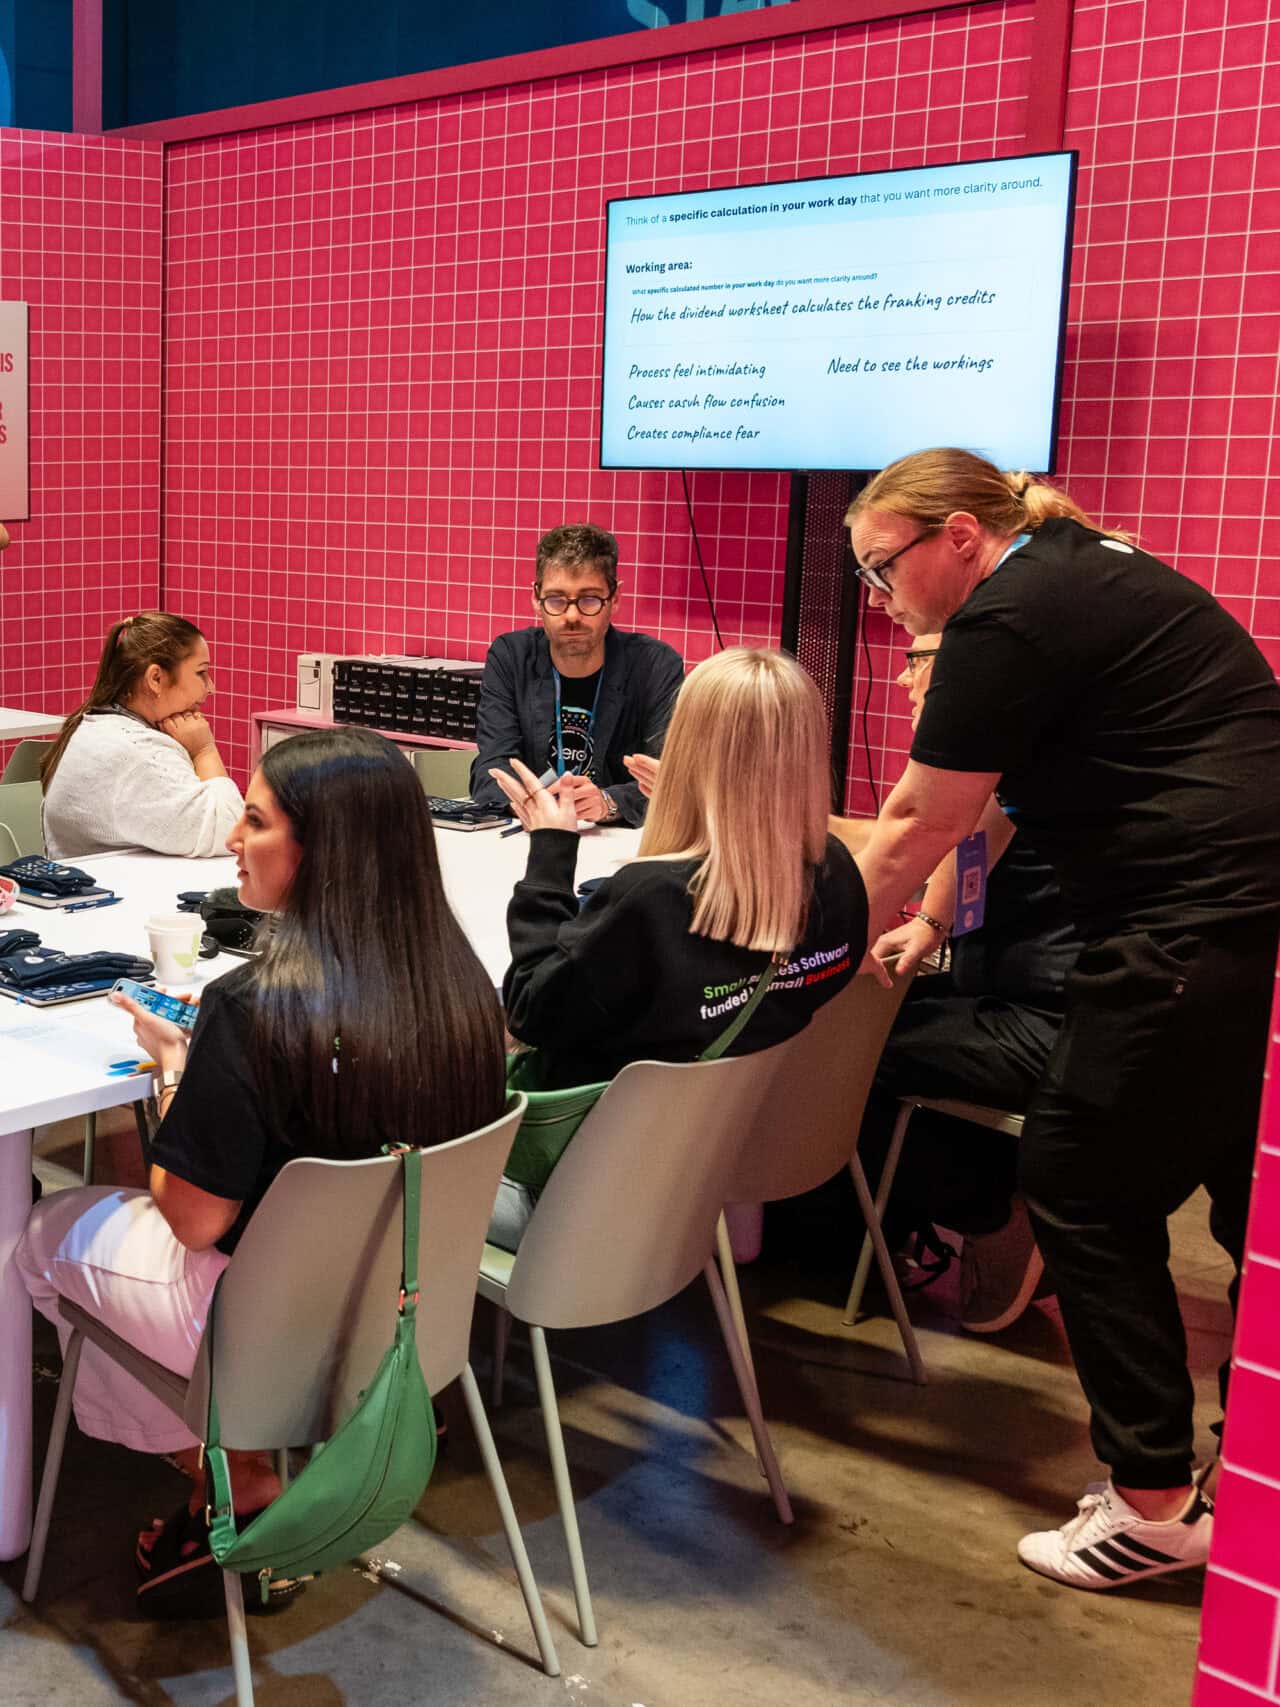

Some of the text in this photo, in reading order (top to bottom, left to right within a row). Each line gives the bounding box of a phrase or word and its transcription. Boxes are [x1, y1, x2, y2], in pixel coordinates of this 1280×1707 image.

[626, 216, 648, 225] Think
[651, 214, 659, 223] of
[669, 209, 709, 225] specific
[711, 205, 767, 218] calculation
[770, 202, 780, 212] in
[782, 202, 805, 213] your
[808, 197, 834, 209] work
[838, 195, 857, 207] day
[860, 193, 880, 203] that
[883, 192, 902, 203] you
[905, 188, 930, 200] want
[933, 185, 961, 197] more
[963, 181, 998, 195] clarity
[1000, 177, 1043, 190] around.
[626, 260, 693, 274] Working area:
[732, 282, 745, 290] your
[747, 280, 762, 288] work
[763, 279, 774, 288] day
[831, 274, 850, 283] clarity
[631, 289, 996, 323] How the dividend worksheet calculates the franking credits
[629, 361, 766, 379] Process feel intimidating
[827, 354, 994, 375] Need to see the workings
[628, 394, 665, 410] Causes
[703, 393, 727, 410] flow
[730, 392, 785, 409] confusion
[627, 424, 761, 443] Creates compliance fear
[700, 988, 749, 1019] funded
